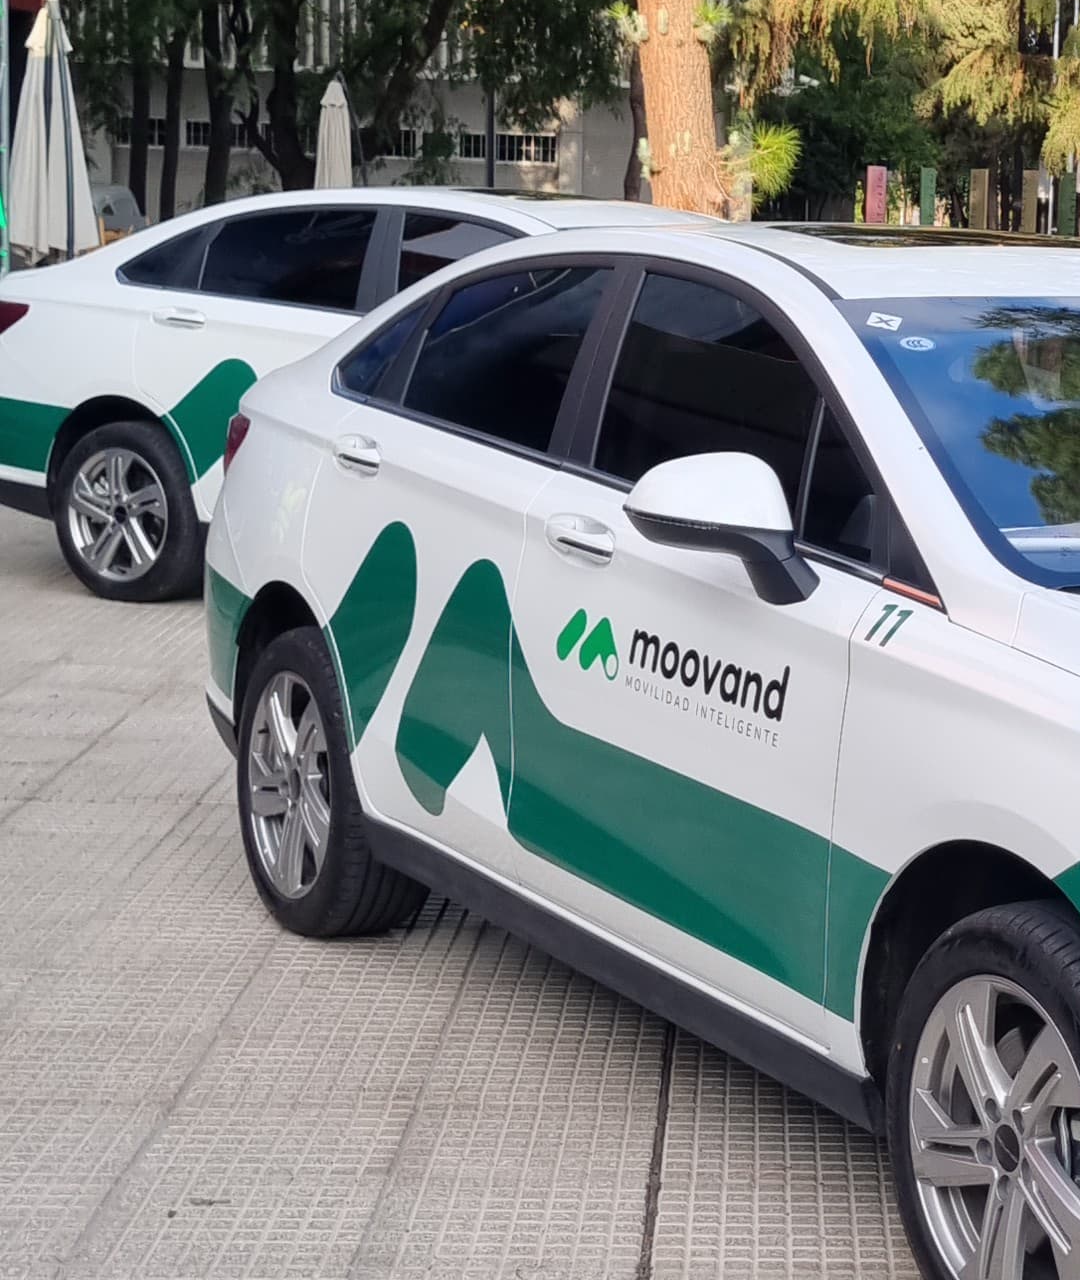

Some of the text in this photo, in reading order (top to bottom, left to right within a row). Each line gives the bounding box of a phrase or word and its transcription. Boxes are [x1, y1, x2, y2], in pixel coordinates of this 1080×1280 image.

[865, 604, 913, 646] 11
[629, 629, 790, 721] moovand
[625, 677, 780, 747] MOVILIDAD INTELIGENTE
